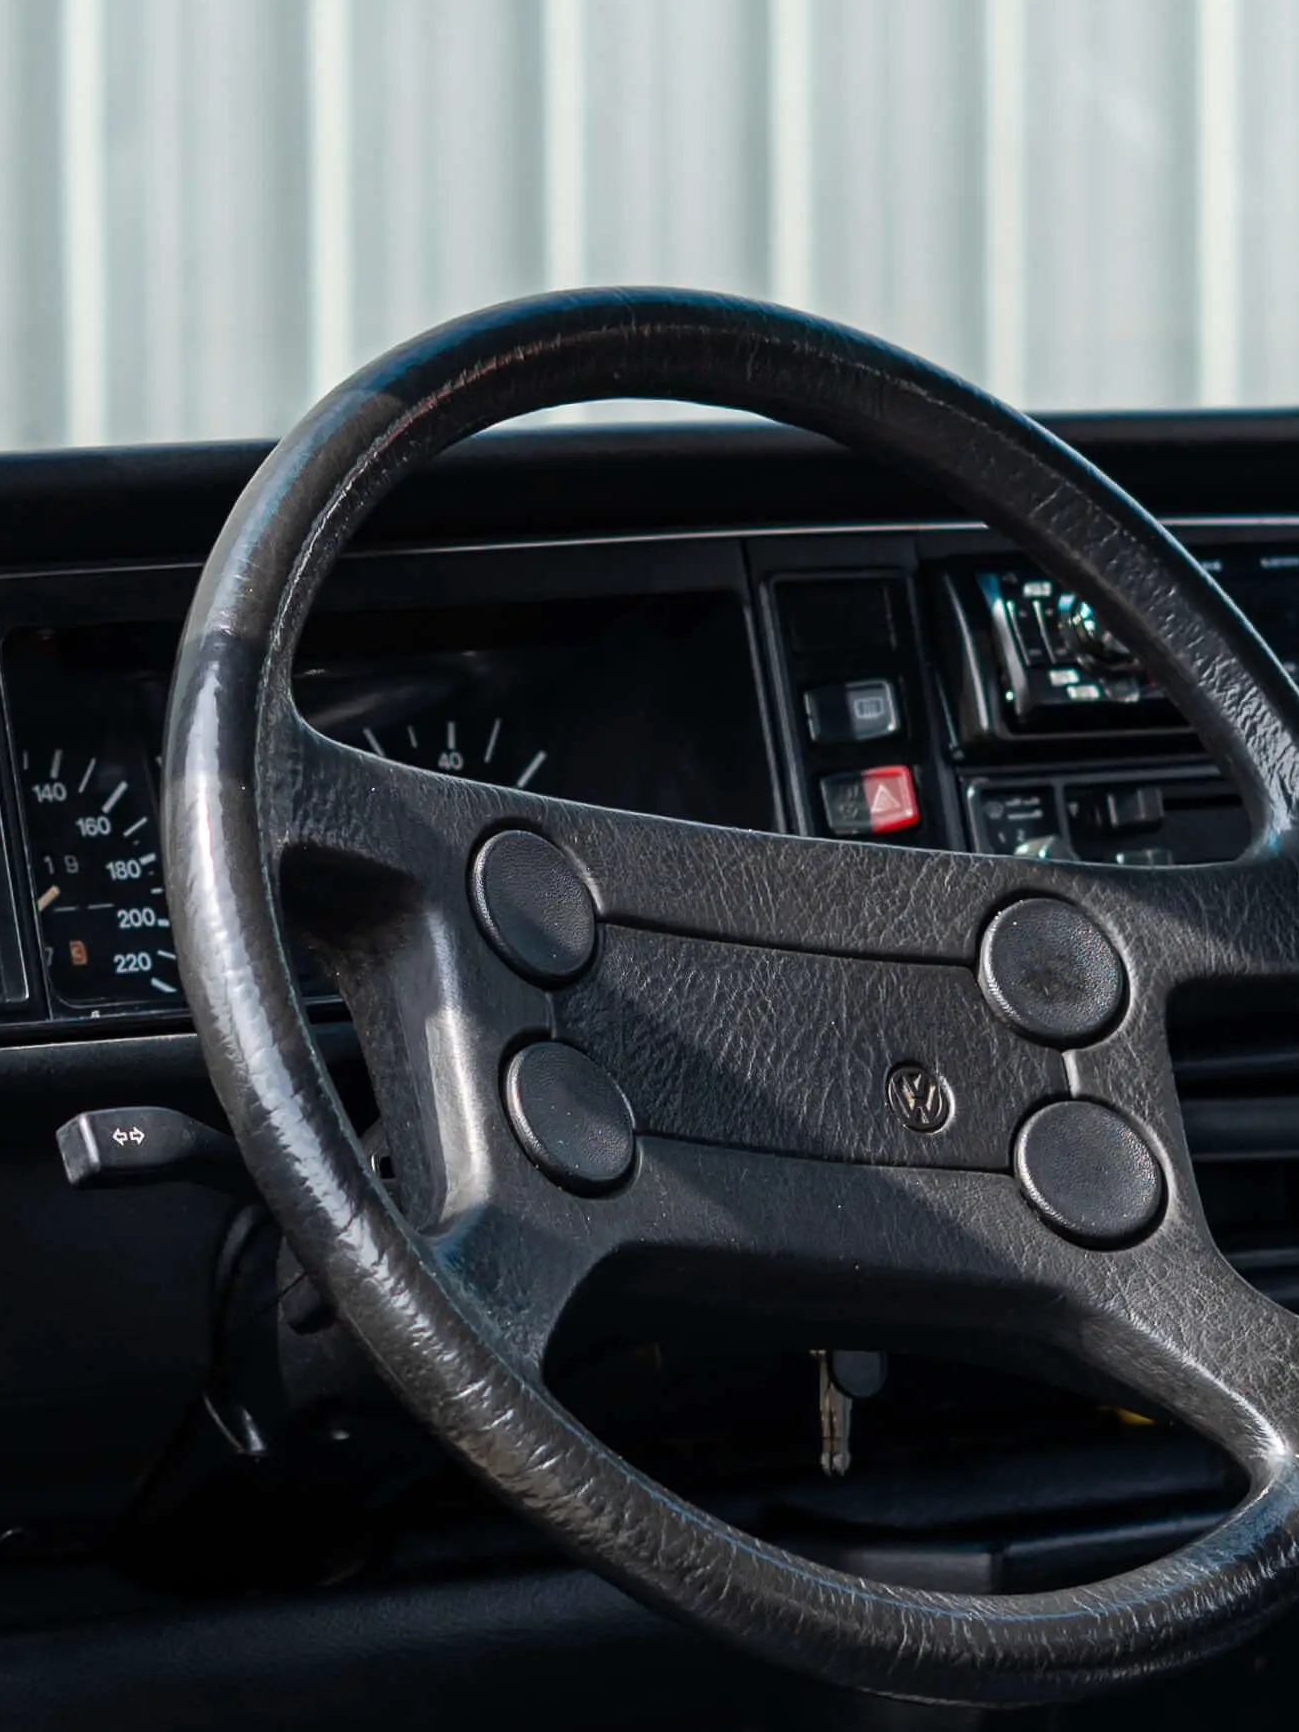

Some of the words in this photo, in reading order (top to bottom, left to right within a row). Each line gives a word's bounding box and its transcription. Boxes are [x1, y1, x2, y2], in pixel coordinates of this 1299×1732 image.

[438, 751, 464, 771] 40
[32, 782, 68, 803] 140
[75, 816, 111, 837] 160
[105, 859, 142, 881] 180
[117, 908, 156, 929] 200
[113, 952, 152, 974] 220
